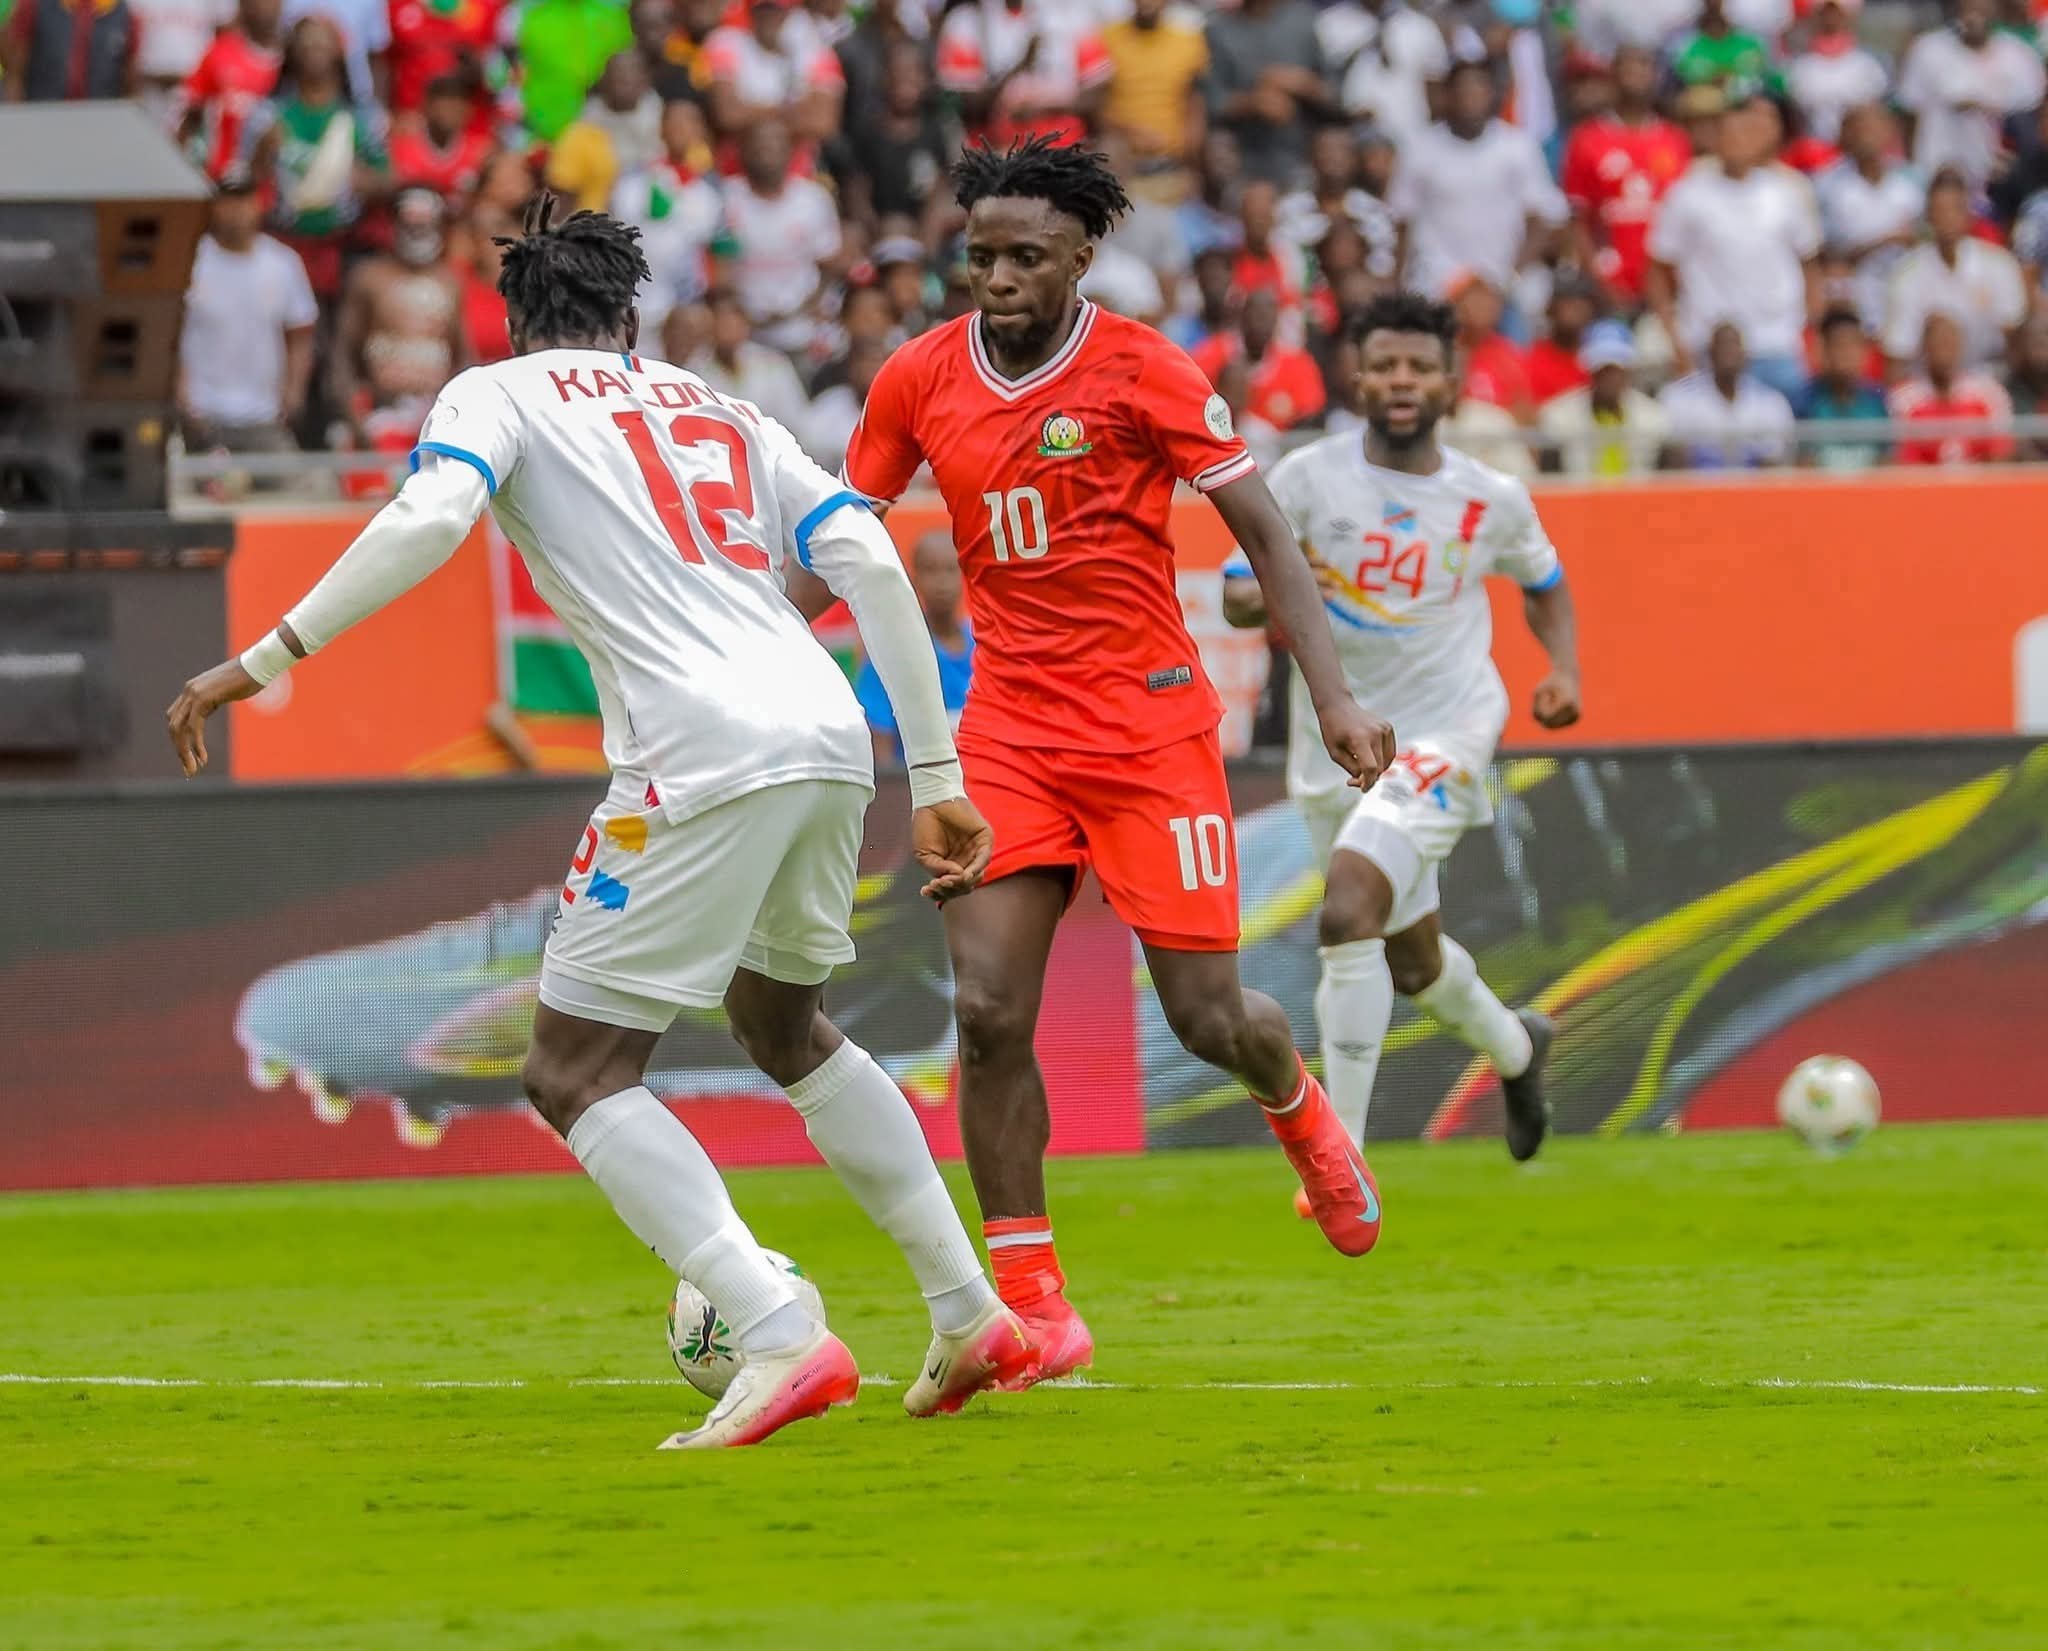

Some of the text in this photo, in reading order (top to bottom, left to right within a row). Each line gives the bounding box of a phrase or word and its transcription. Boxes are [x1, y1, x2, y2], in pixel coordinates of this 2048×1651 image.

[611, 410, 770, 571] 12
[983, 486, 1050, 562] 10
[1356, 533, 1429, 600] 24
[1168, 813, 1227, 891] 10
